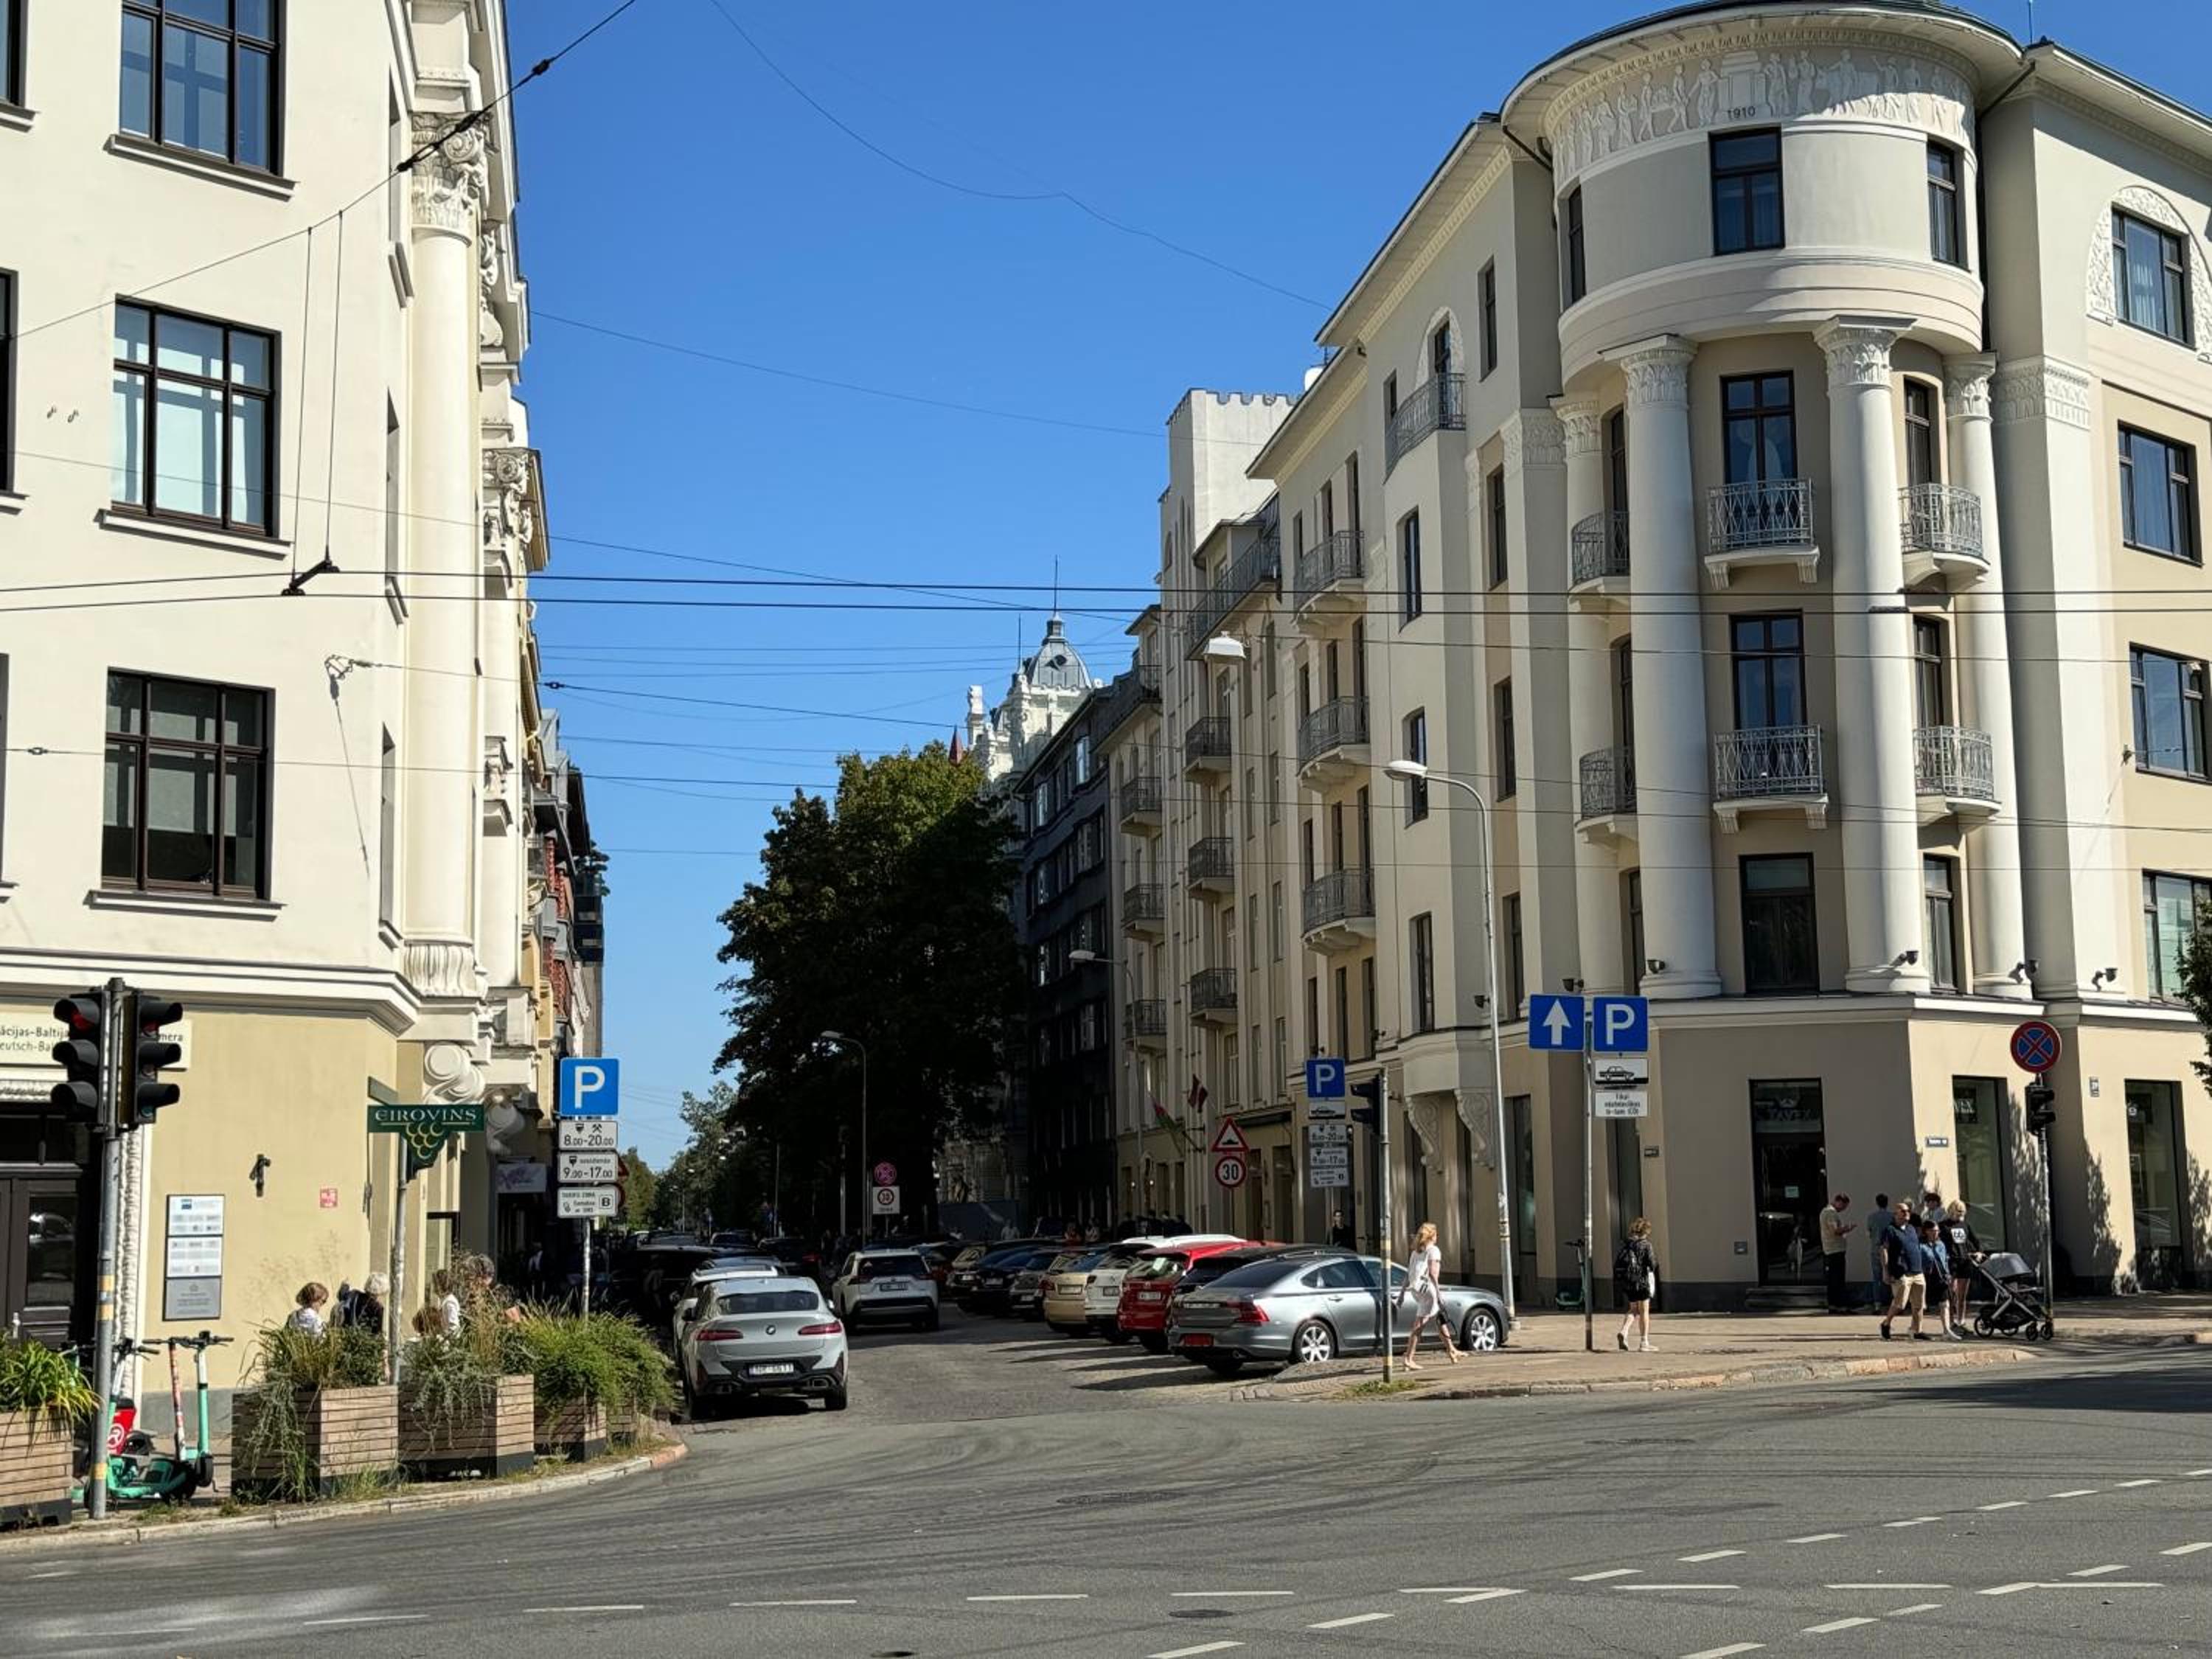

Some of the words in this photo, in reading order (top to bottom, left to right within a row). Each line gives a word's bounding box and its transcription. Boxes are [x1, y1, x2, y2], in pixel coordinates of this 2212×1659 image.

[1728, 106, 1756, 119] 1910
[1606, 1004, 1635, 1045] P
[1315, 1065, 1335, 1093] P
[574, 1065, 605, 1109] P
[375, 1109, 477, 1121] EIROVINS
[564, 1134, 614, 1146] 8.00-20.00
[563, 1167, 613, 1178] 9.00-17.00
[1222, 1164, 1239, 1180] 30
[601, 1197, 611, 1207] B
